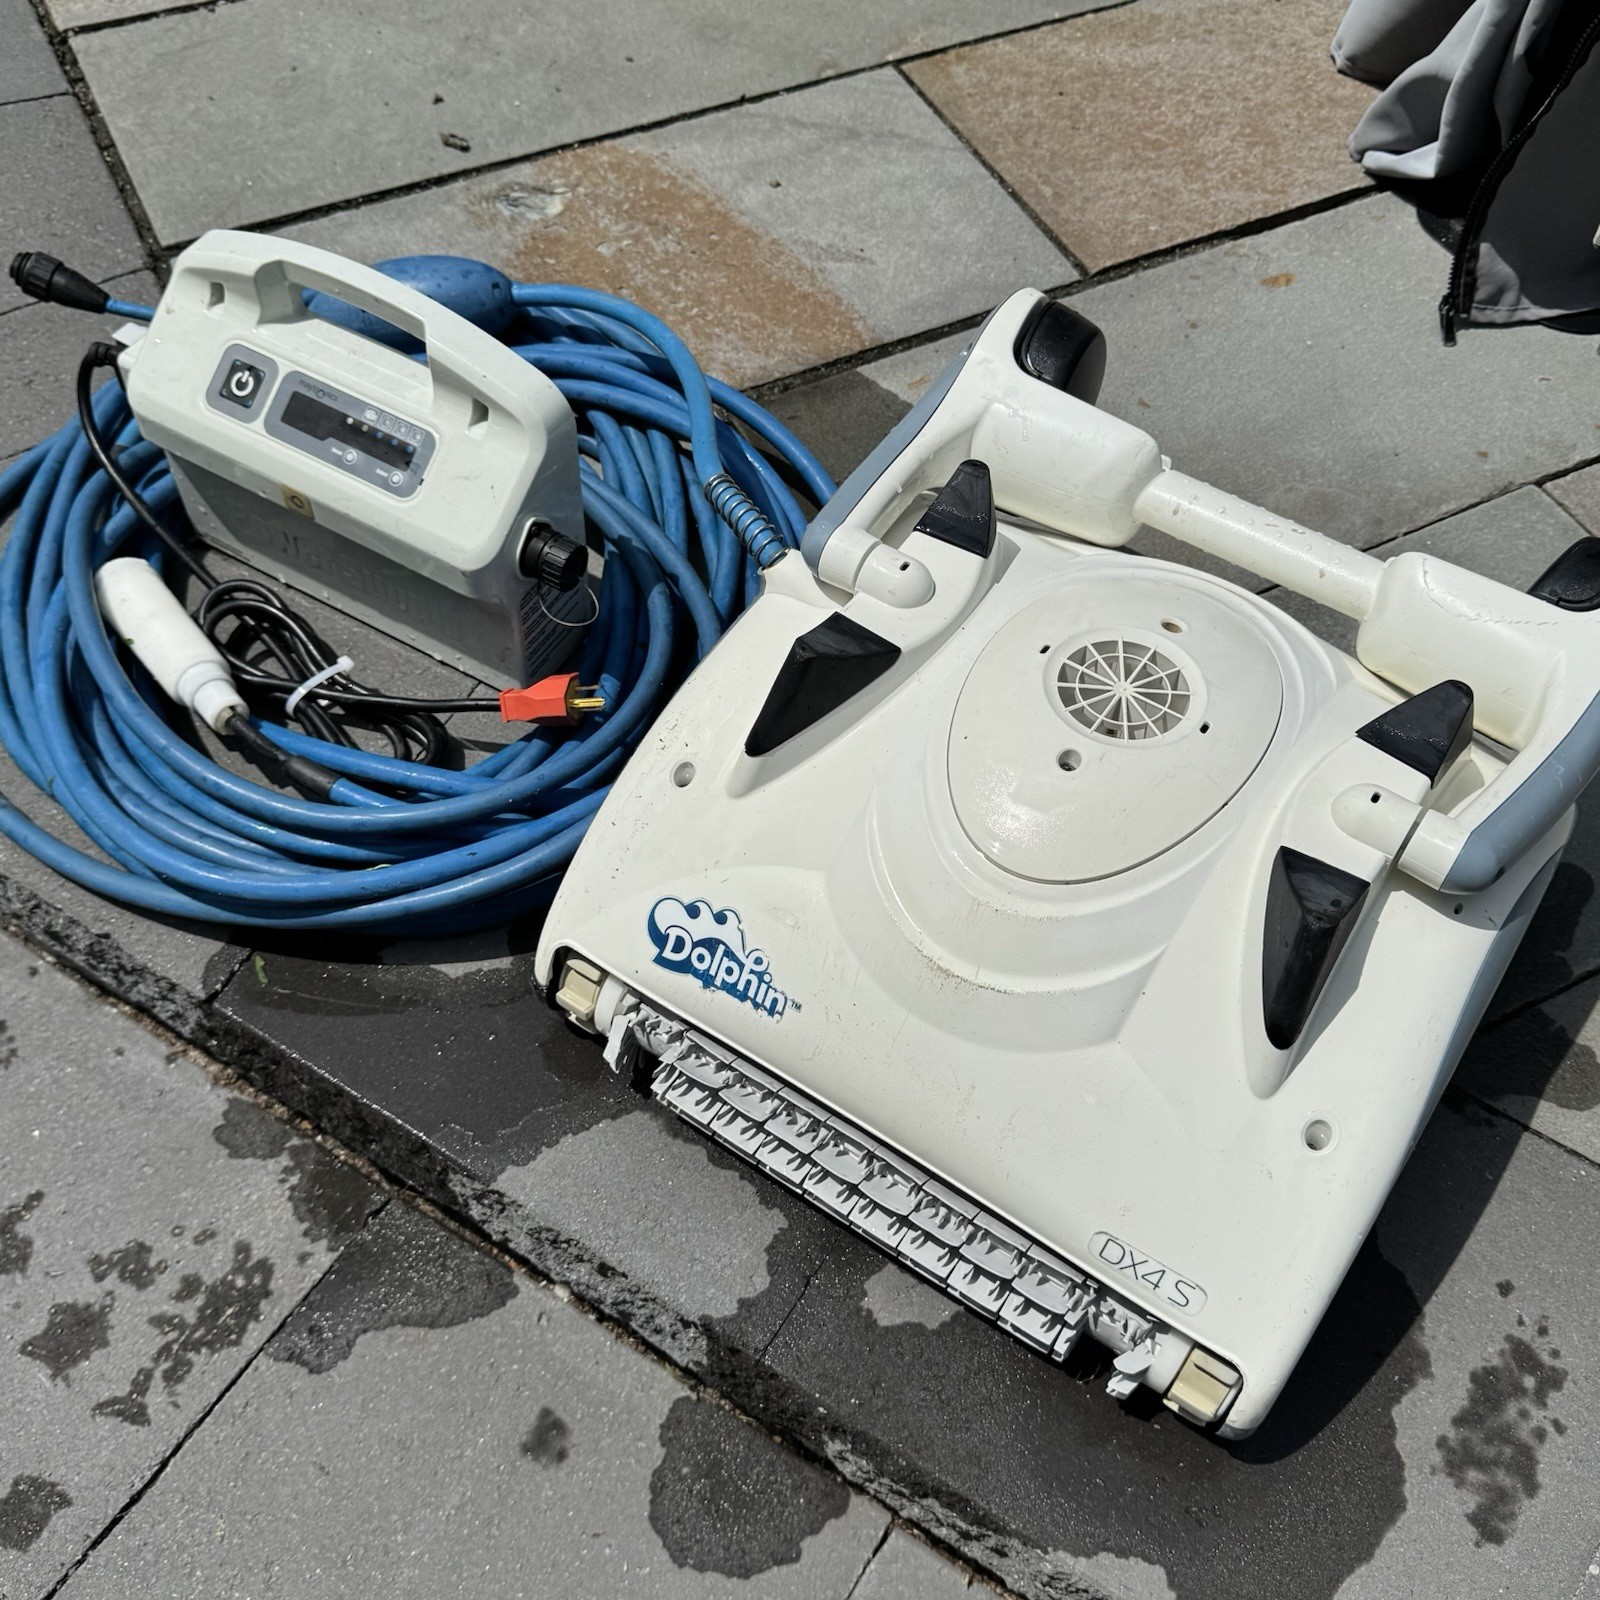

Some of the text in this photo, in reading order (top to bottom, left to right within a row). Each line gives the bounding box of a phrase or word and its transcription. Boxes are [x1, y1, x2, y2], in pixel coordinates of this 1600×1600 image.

[661, 926, 787, 1021] Dolphin
[1099, 1238, 1196, 1308] DX4 S
